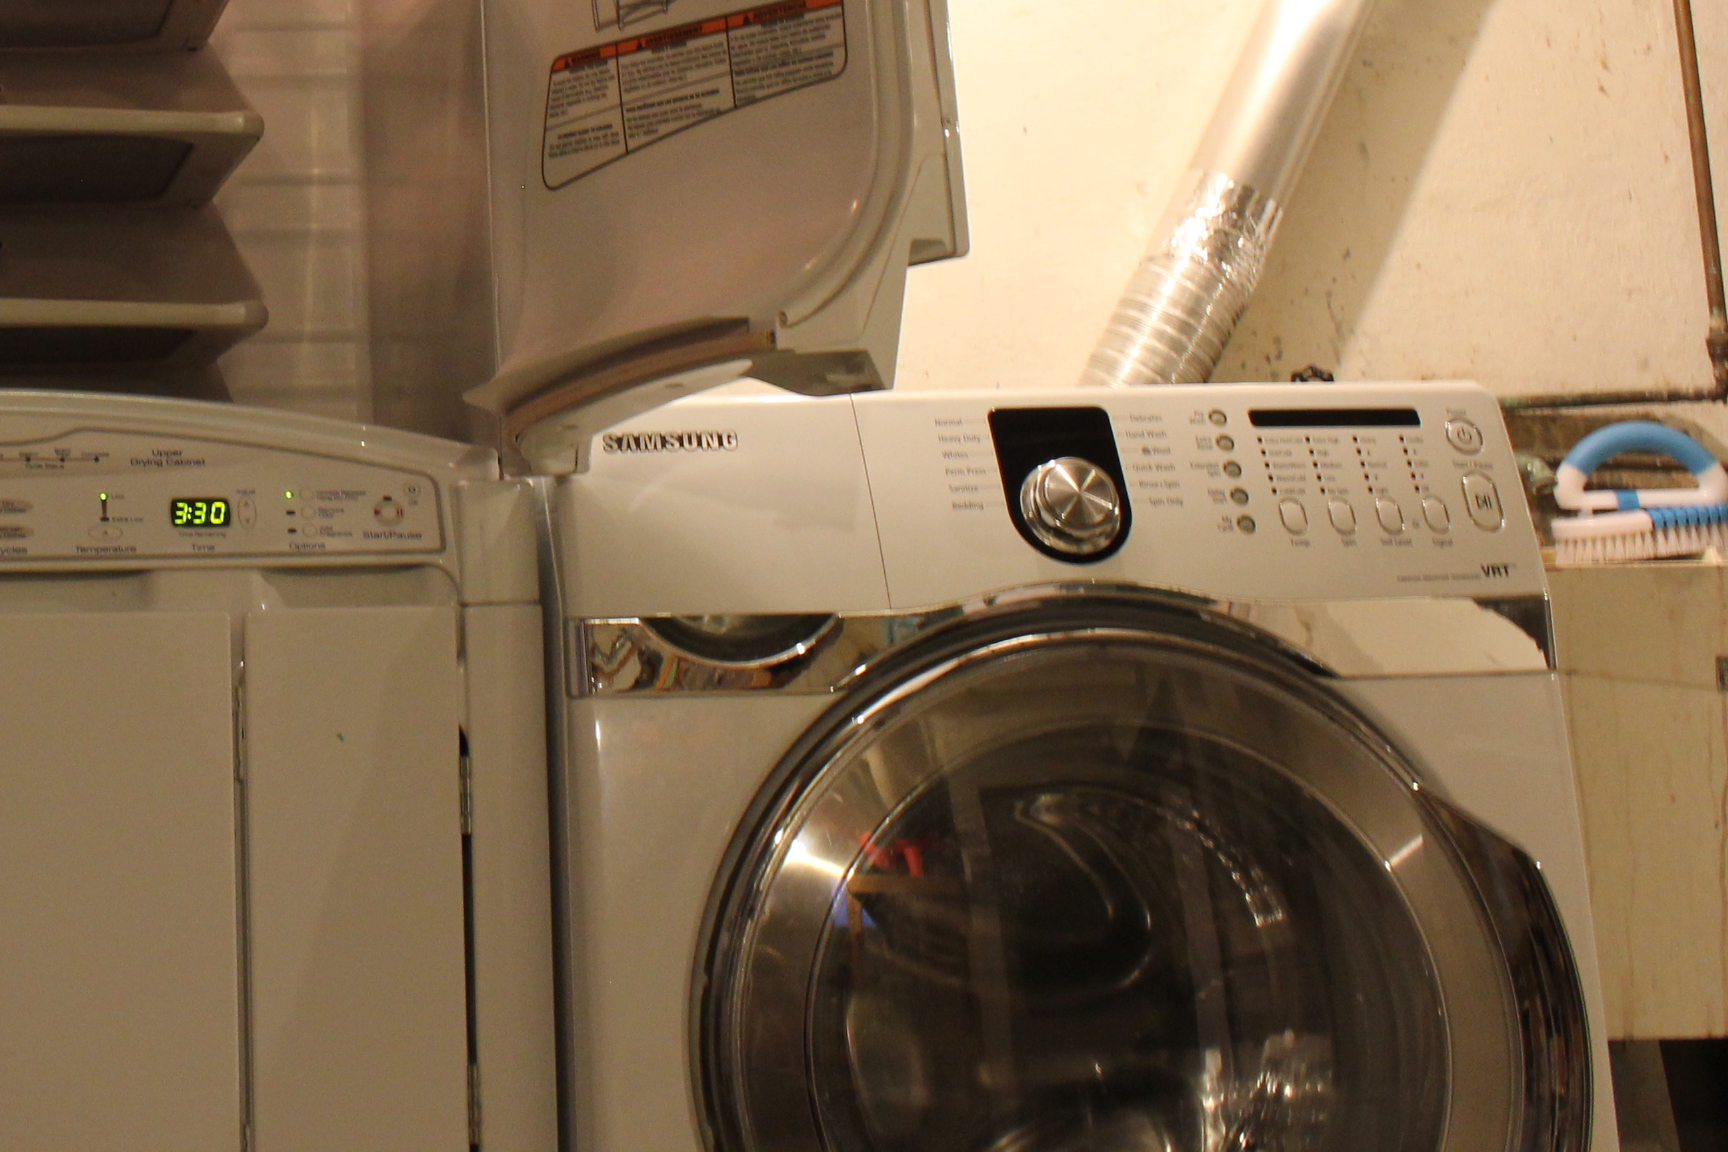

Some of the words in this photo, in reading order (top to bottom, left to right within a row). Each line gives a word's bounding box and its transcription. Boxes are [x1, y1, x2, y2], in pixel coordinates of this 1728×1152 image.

[602, 430, 738, 453] SAMSUNG
[152, 448, 183, 458] Upper
[130, 458, 163, 467] Drying
[166, 457, 206, 466] Cabinet
[174, 501, 226, 525] 3:30
[362, 530, 422, 540] Start/Pause
[76, 545, 137, 554] Temperature
[192, 543, 215, 552] Time
[289, 542, 326, 552] Options
[1480, 562, 1510, 578] VRT
